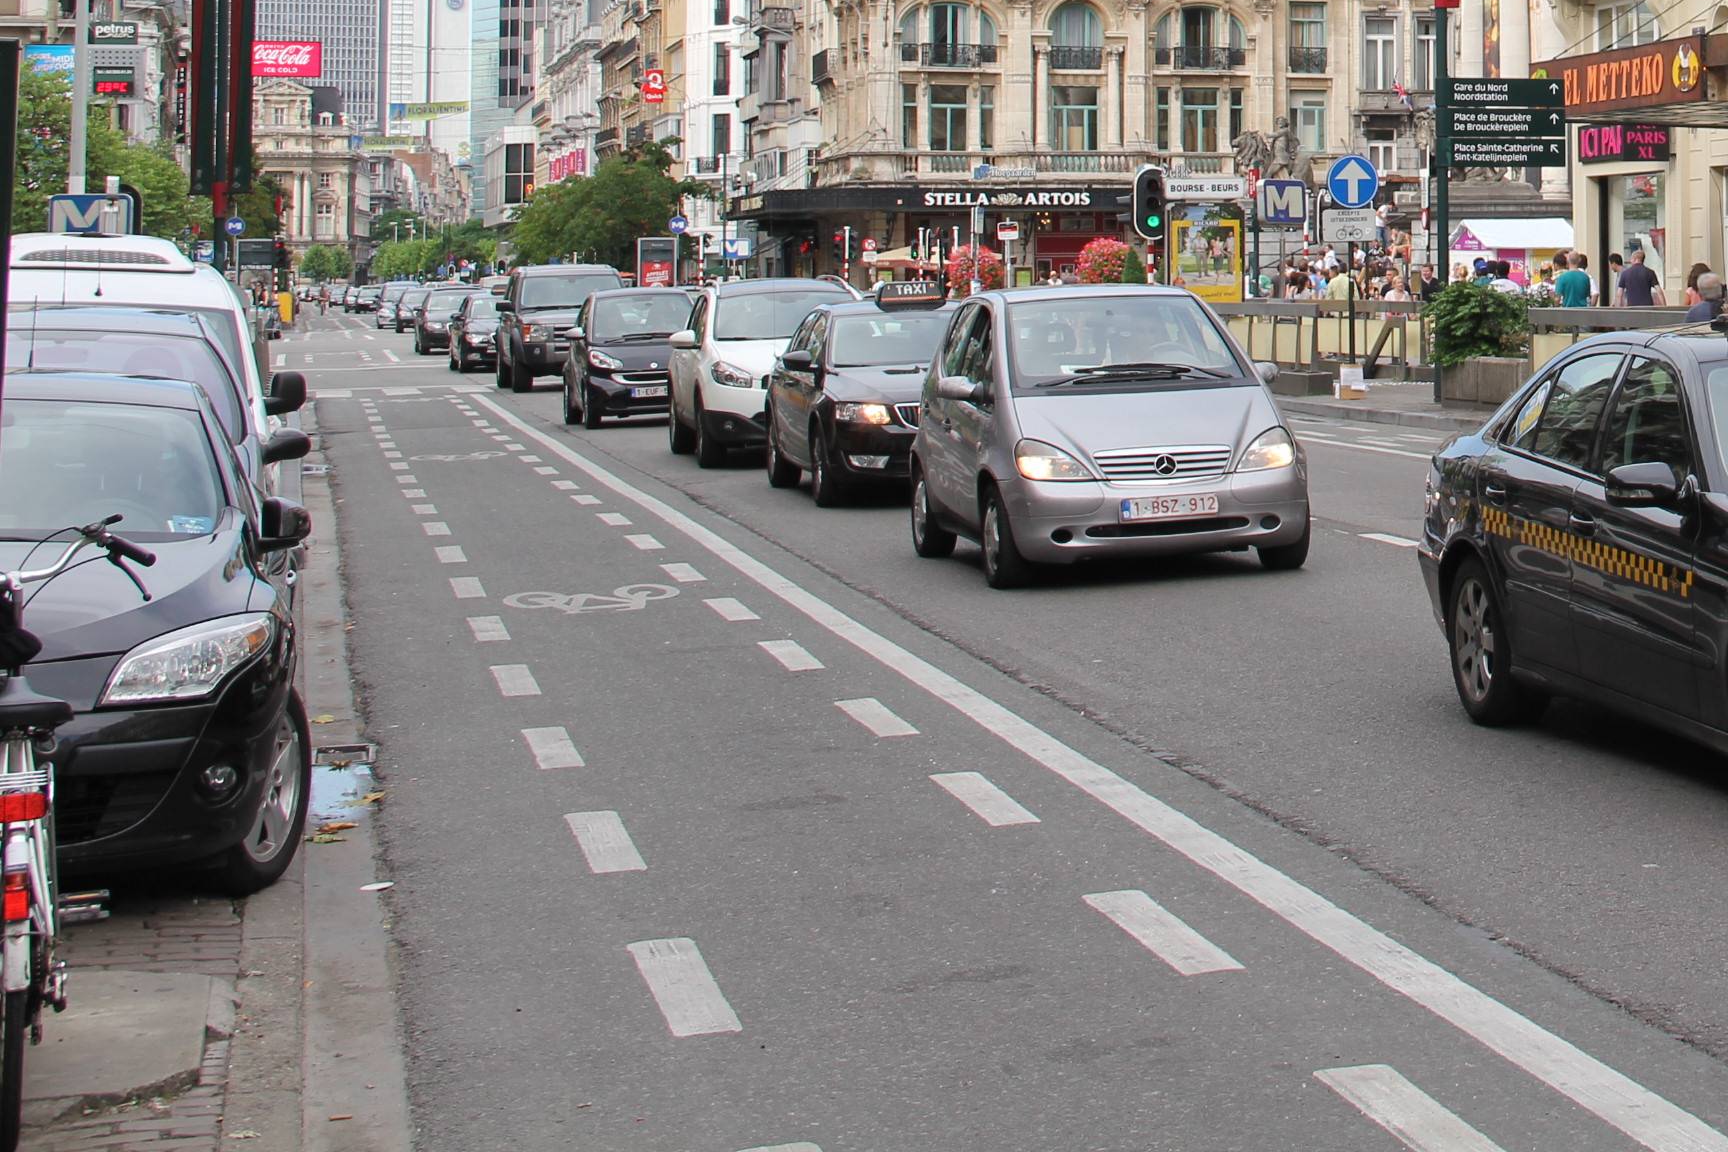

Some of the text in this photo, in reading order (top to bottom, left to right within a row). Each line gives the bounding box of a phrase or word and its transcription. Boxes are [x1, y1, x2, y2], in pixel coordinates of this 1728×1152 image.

[95, 23, 135, 37] petrus
[1563, 52, 1664, 106] EL METTEKO
[1453, 83, 1508, 92] Gare du Nord
[1453, 93, 1508, 101] Noordstation
[1453, 112, 1532, 122] Place de Brouckère
[1453, 122, 1529, 132] De Brouckèreplein
[1580, 128, 1599, 158] ICI
[1626, 131, 1666, 145] PARIS
[1453, 143, 1544, 152] Place Sainte-Catherine
[1638, 145, 1656, 159] XL
[1453, 152, 1528, 163] Sint-Katelijneplein
[990, 166, 1036, 179] Hoegaarden
[1170, 184, 1205, 193] BOURSE
[1211, 183, 1240, 192] BEURS
[924, 192, 1091, 206] STELLA ARTOIS
[1266, 185, 1304, 218] M
[896, 285, 927, 295] TAXI
